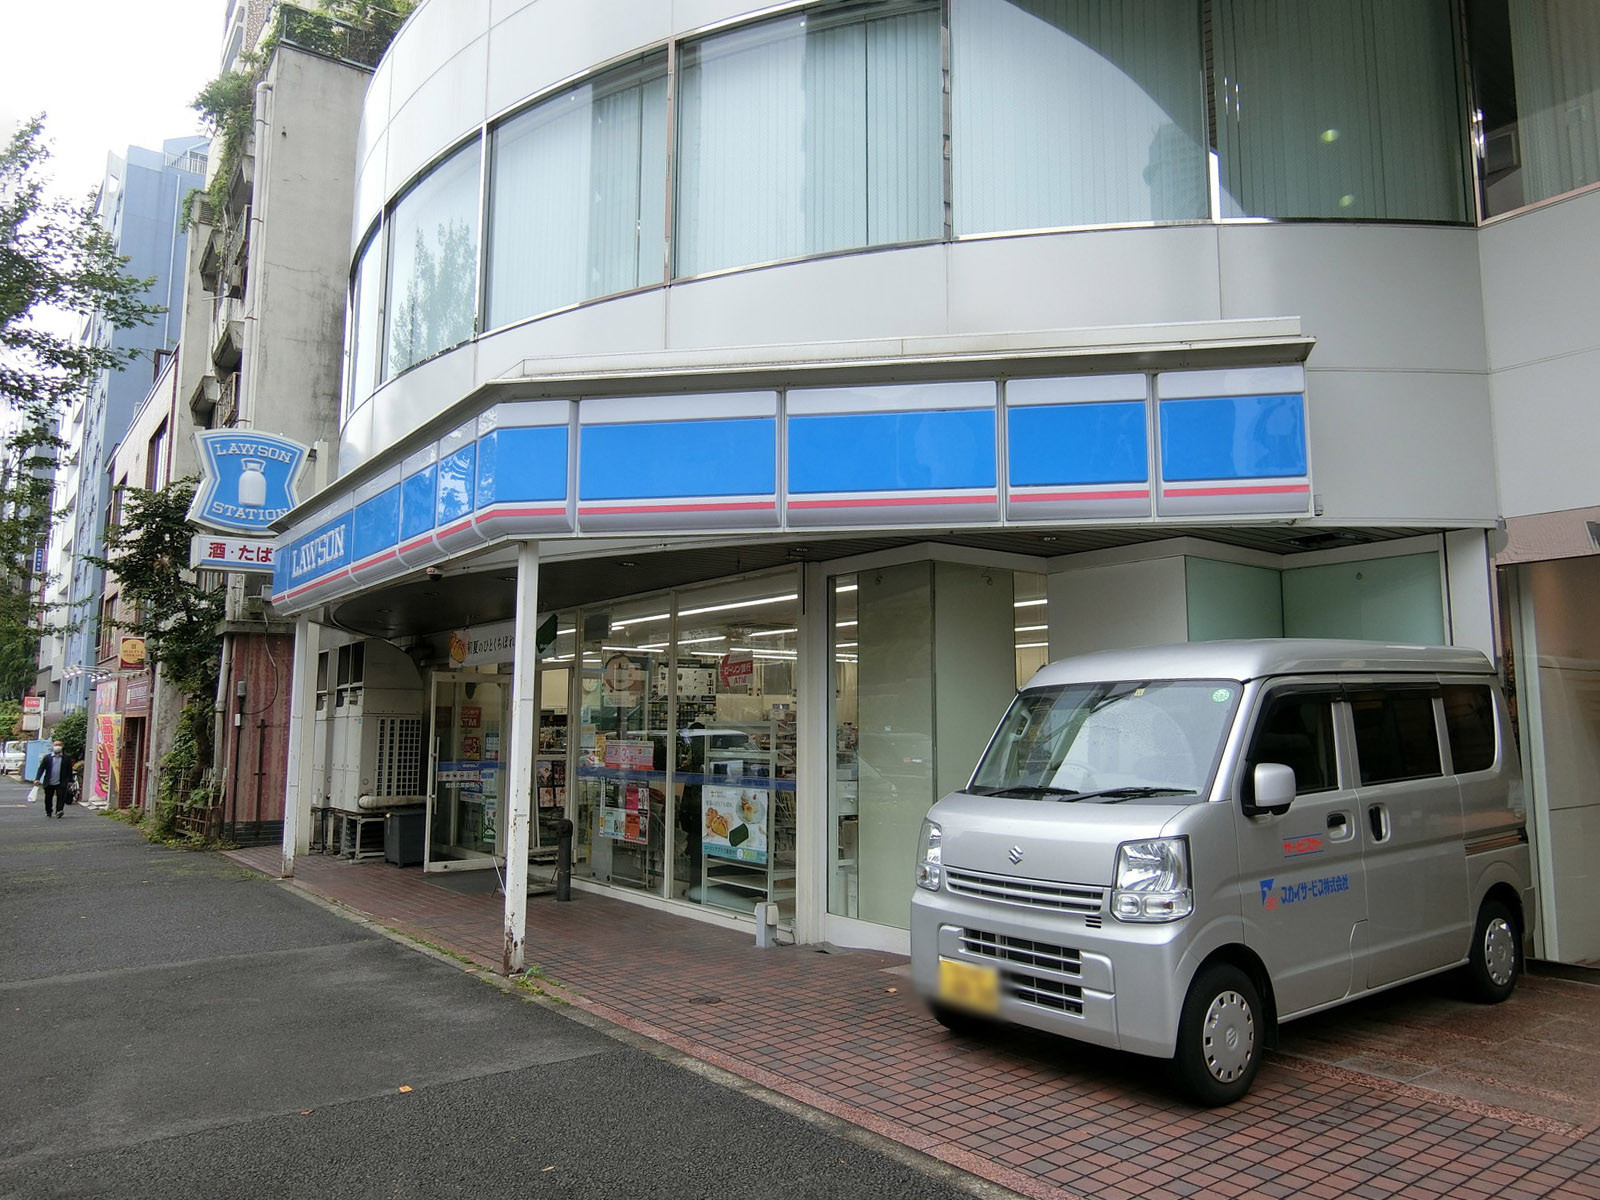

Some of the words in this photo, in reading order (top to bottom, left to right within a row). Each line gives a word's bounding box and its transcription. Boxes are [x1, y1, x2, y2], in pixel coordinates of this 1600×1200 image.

[213, 442, 293, 465] LAWSON
[211, 501, 290, 521] STATION
[291, 523, 347, 579] LAWSON
[733, 676, 747, 685] ATM
[1281, 874, 1350, 904] スカイサービス株式会社
